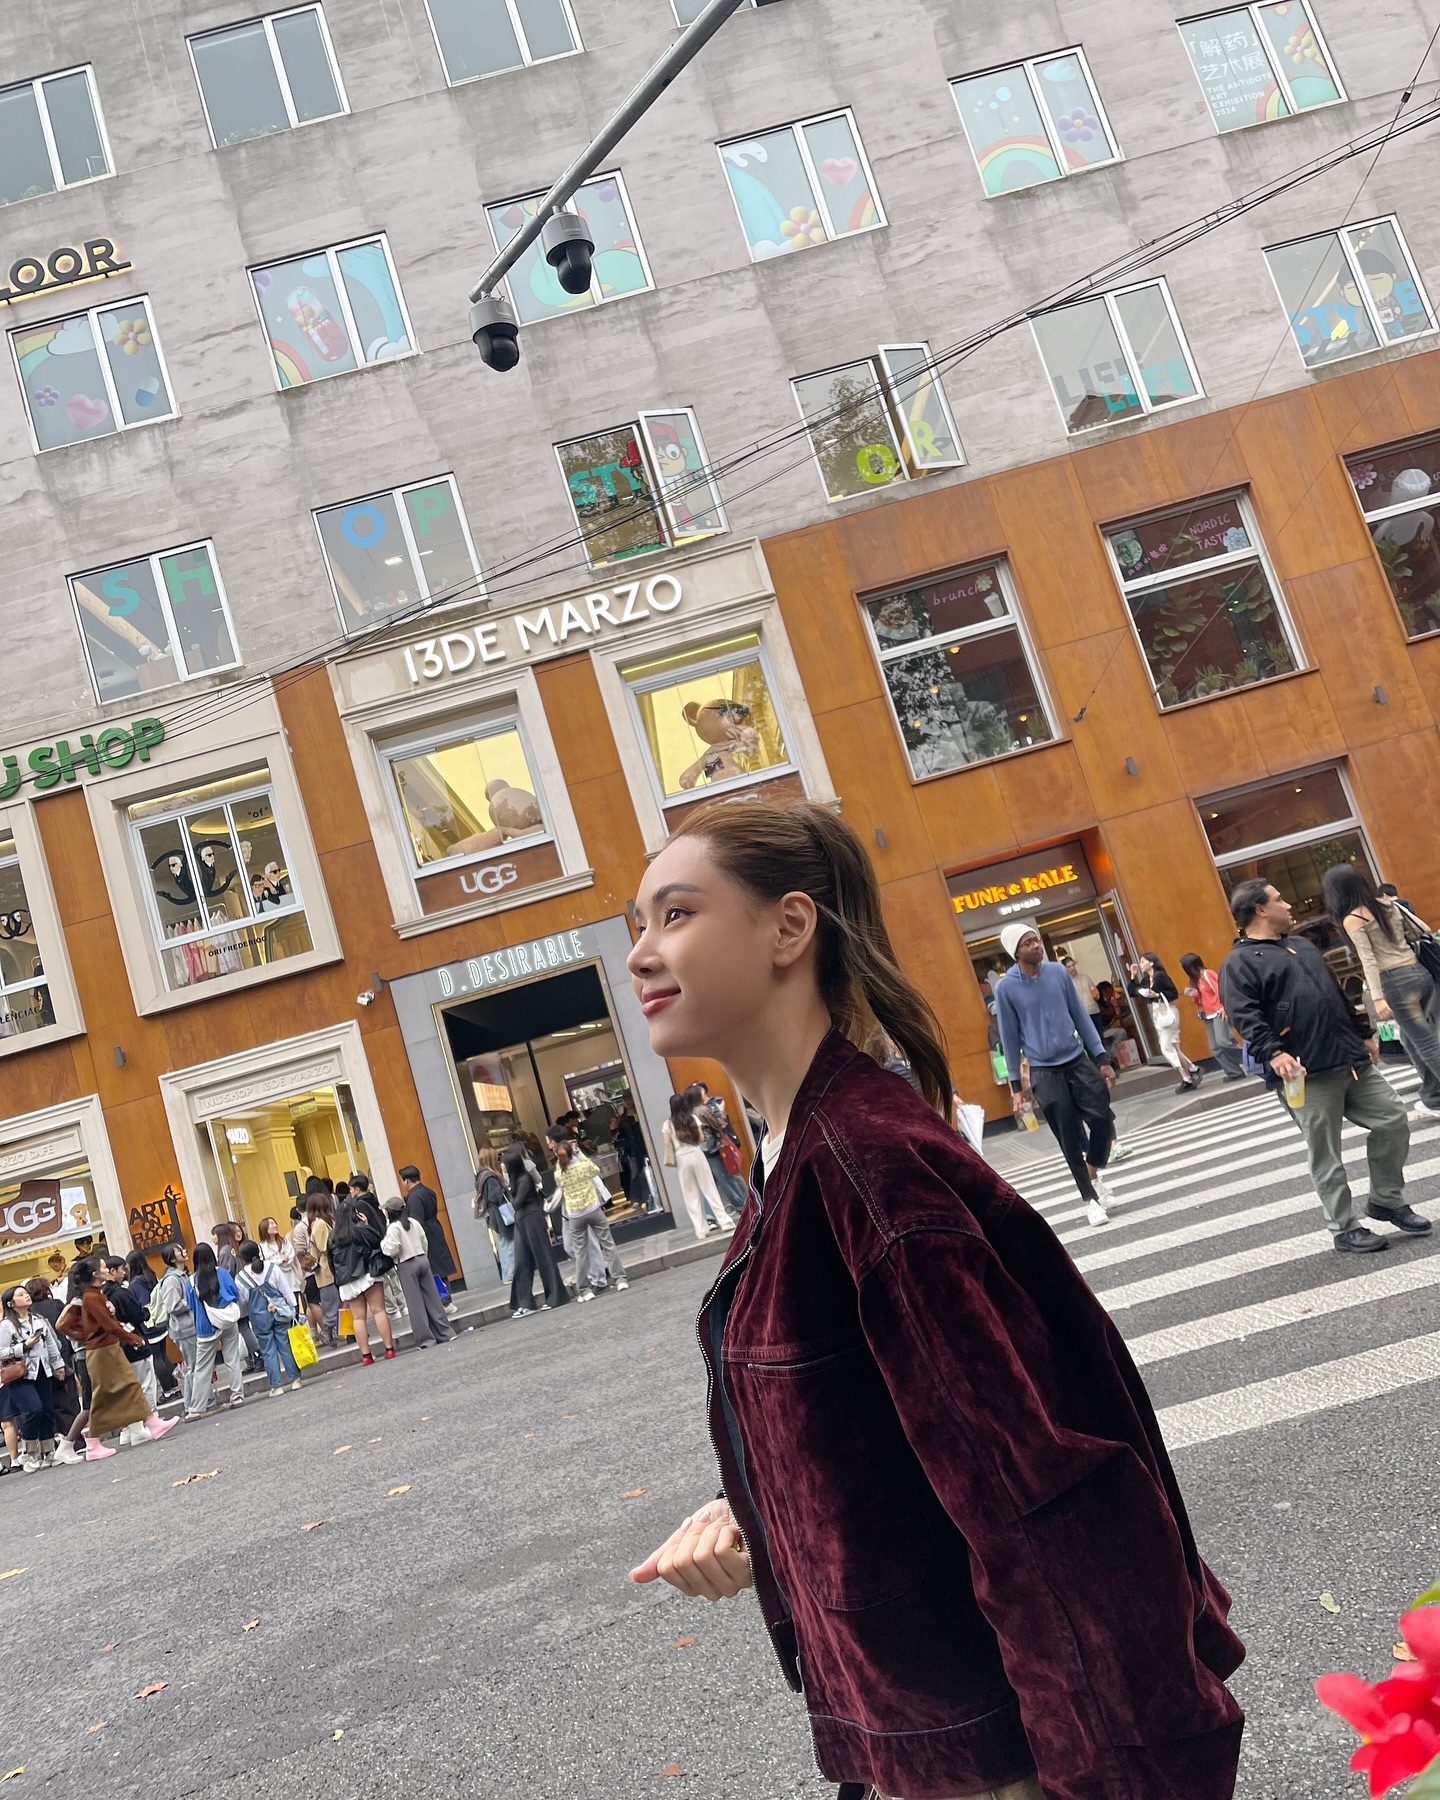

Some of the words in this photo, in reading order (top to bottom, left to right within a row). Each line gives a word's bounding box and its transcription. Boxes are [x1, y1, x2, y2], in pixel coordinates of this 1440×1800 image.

[1206, 84, 1224, 94] THE
[1210, 91, 1228, 102] ART
[1213, 90, 1265, 109] EXHIBITION
[1216, 107, 1236, 117] 2024
[1189, 513, 1231, 537] NORDIC
[933, 584, 983, 606] brunch
[403, 622, 507, 684] 13DE
[513, 573, 683, 653] MARZO
[460, 863, 518, 894] UGG
[951, 886, 1008, 914] FUNK
[1008, 883, 1022, 896] &
[1021, 863, 1079, 894] KALE
[290, 1063, 332, 1085] MARZO
[129, 1199, 169, 1226] ART
